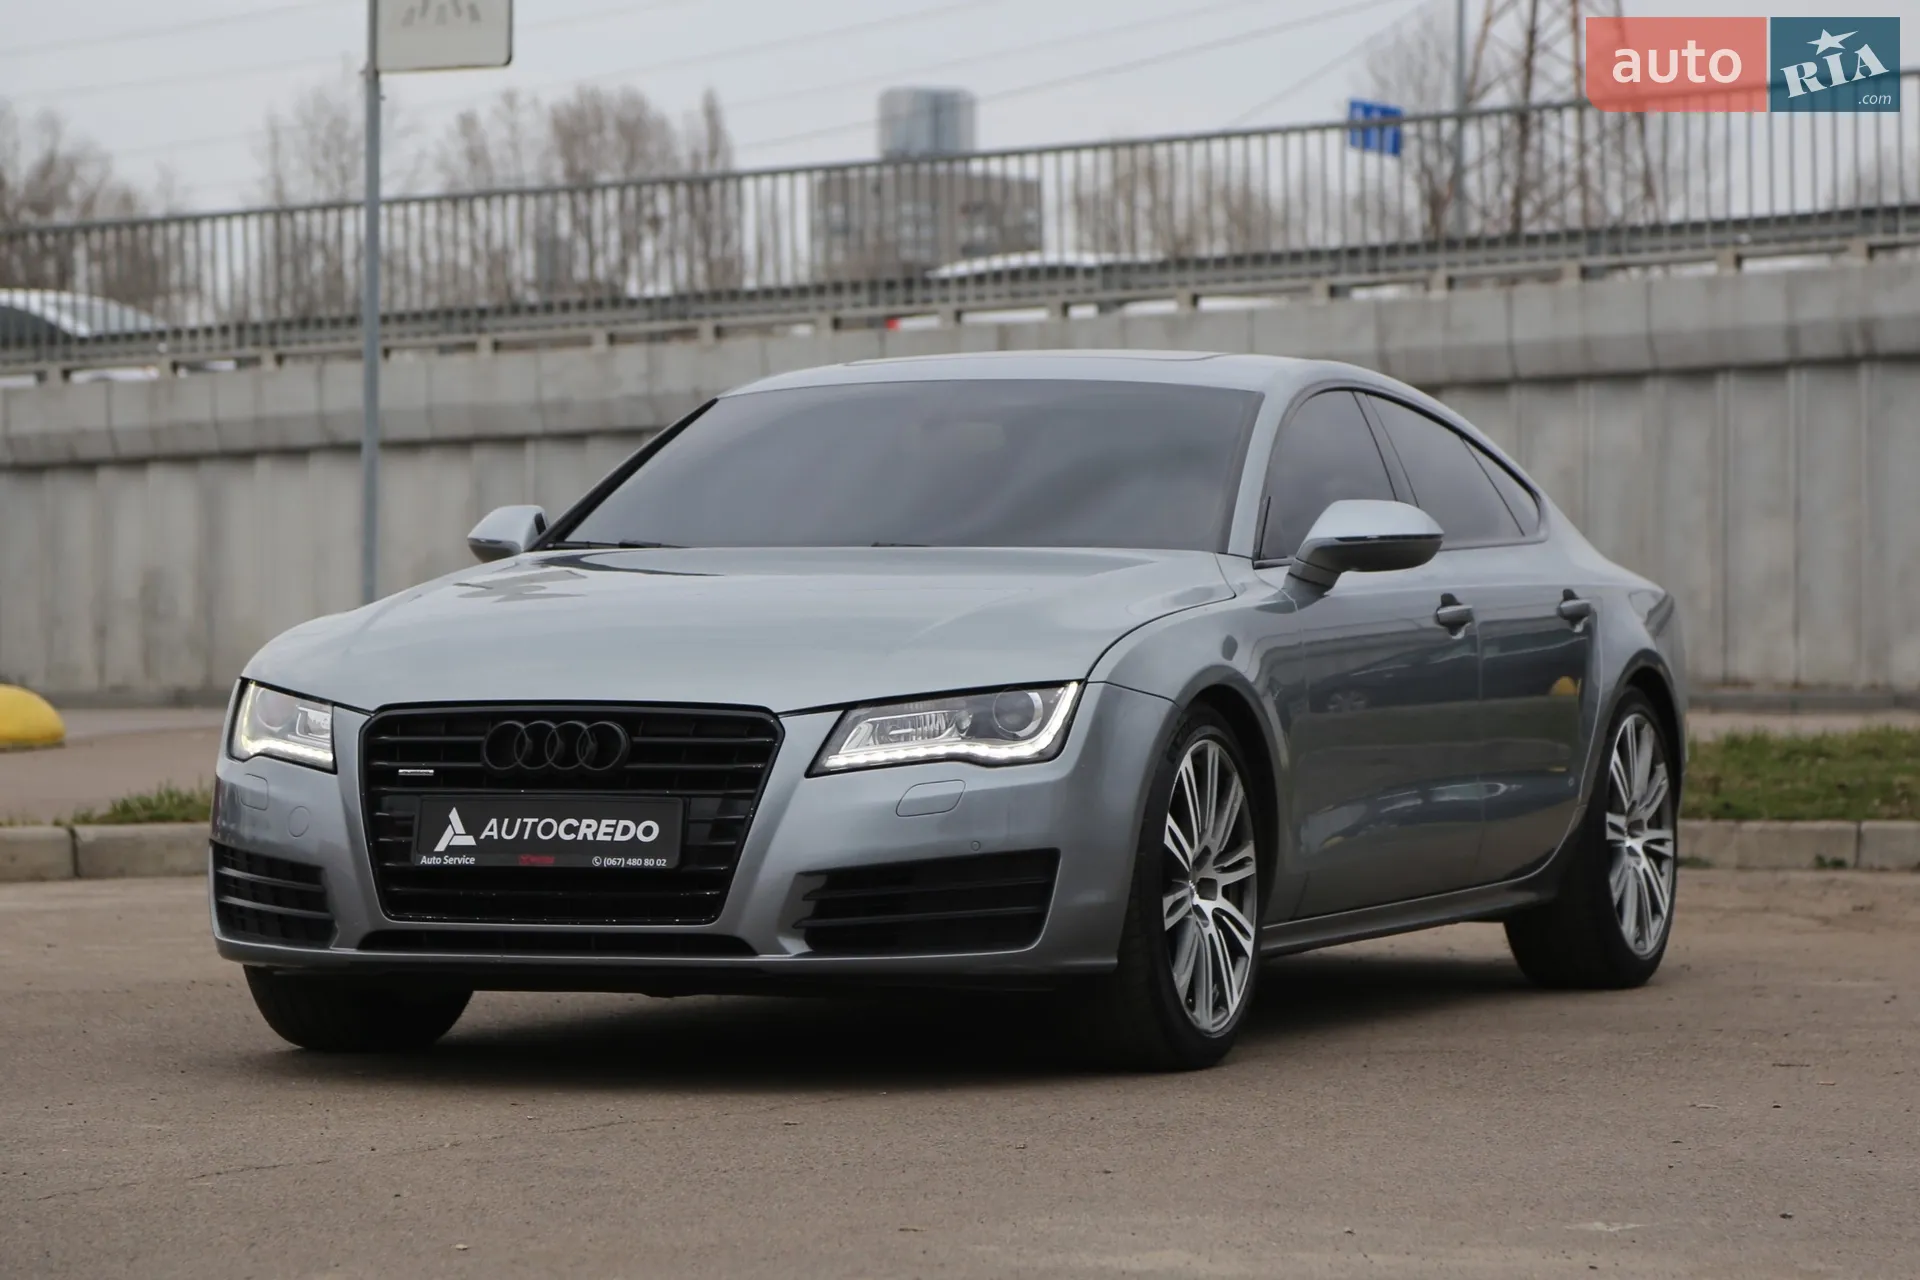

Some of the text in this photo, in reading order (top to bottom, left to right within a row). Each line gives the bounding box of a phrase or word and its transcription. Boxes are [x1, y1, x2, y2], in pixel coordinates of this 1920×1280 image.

[479, 818, 660, 842] AUTOCREDO
[420, 855, 476, 865] Auto Service
[603, 857, 667, 868] (067) 480 80 02
